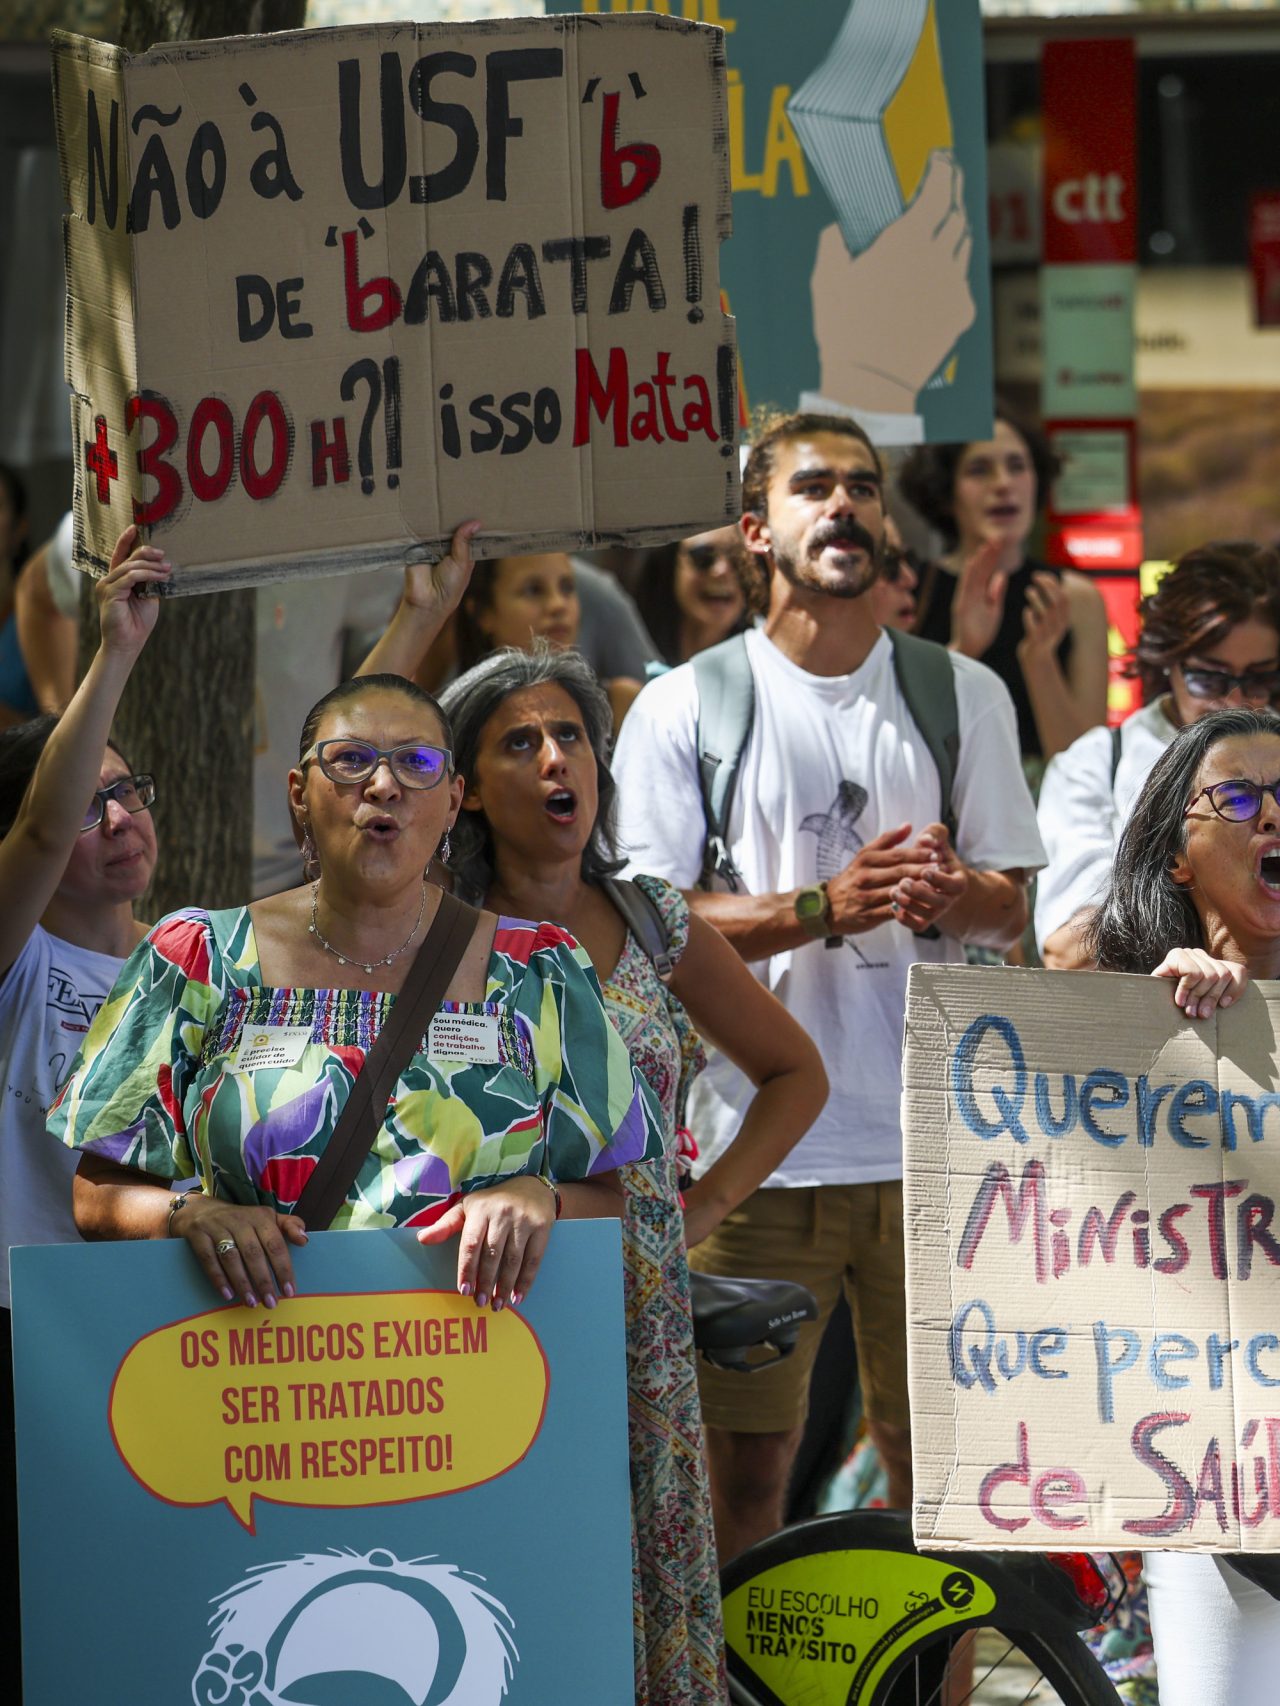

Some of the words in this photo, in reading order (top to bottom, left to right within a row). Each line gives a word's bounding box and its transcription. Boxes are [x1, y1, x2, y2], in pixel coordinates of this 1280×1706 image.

[86, 89, 227, 234] NÃO
[338, 48, 564, 210] USF
[236, 275, 313, 342] DE
[440, 384, 562, 459] isso
[241, 1054, 271, 1063] cuidar
[250, 1047, 285, 1056] preciso
[433, 1033, 479, 1043] condições
[446, 1041, 485, 1051] trabalho
[239, 1061, 266, 1070] quem
[180, 1330, 220, 1369] OS
[228, 1319, 365, 1367] MÉDICOS
[374, 1316, 489, 1358] EXIGEM
[951, 1300, 1068, 1393] Que
[221, 1384, 280, 1425] SER
[287, 1376, 445, 1422] TRATADOS
[223, 1444, 292, 1484] COM
[300, 1434, 454, 1479] RESPEITO!
[978, 1422, 1090, 1533] de
[746, 1610, 824, 1637] MENOS
[748, 1587, 775, 1609] EU
[780, 1590, 879, 1619] ESCOLHO
